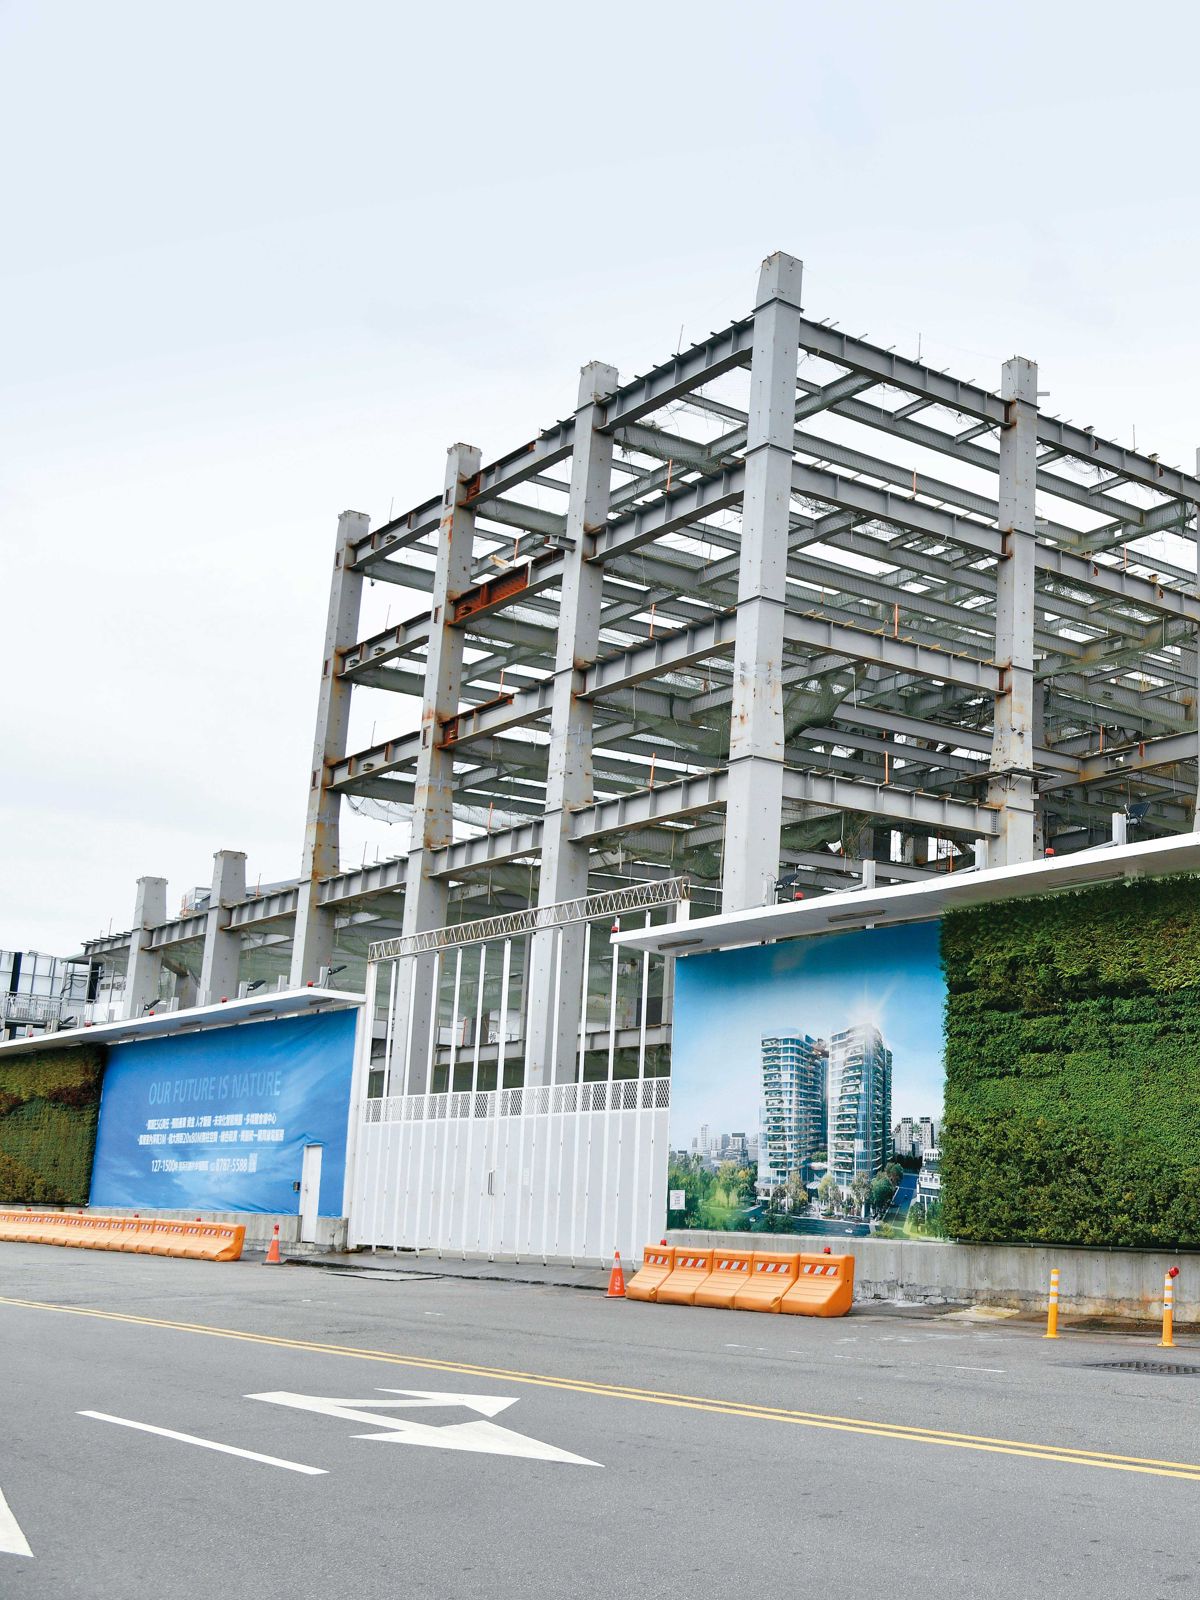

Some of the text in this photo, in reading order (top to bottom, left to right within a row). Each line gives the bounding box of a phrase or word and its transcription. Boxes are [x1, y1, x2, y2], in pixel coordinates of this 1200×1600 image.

[149, 1070, 282, 1105] OUR FUTURE IS NATURE
